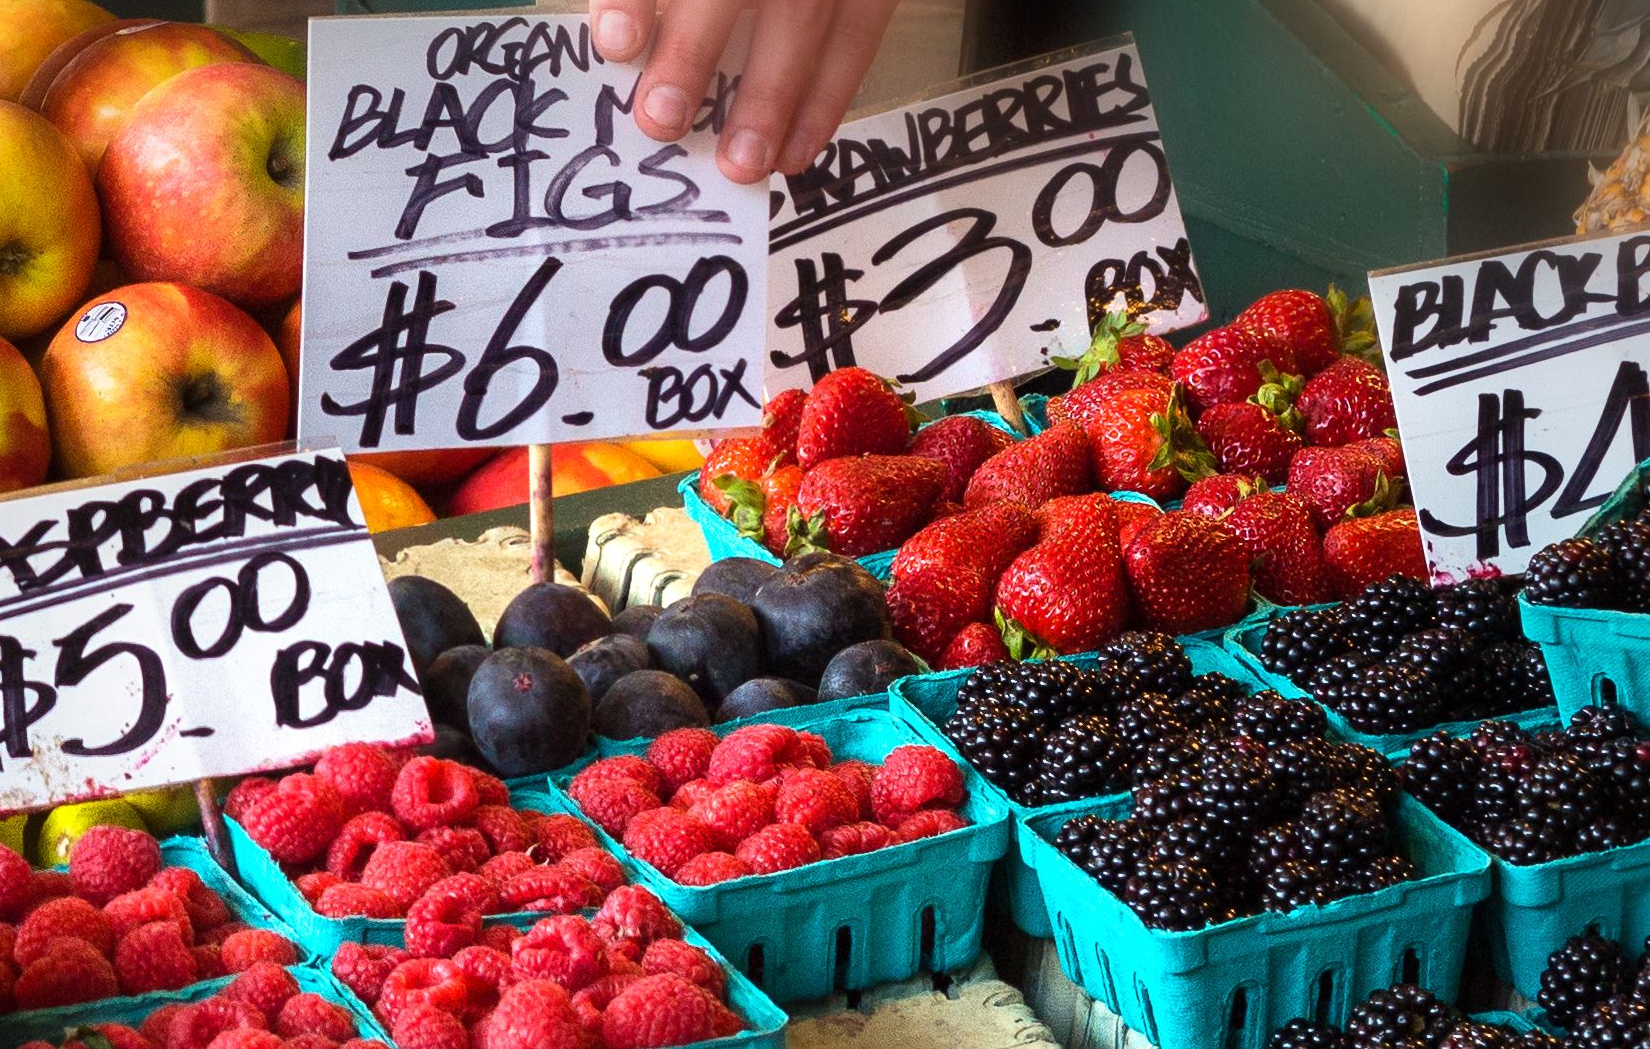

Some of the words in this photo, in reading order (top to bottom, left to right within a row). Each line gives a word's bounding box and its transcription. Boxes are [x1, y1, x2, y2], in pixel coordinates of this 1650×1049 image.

[425, 16, 605, 82] ORGAN
[328, 75, 570, 163] BLACK
[769, 52, 1153, 219] RAWBERRIES
[394, 143, 702, 240] FIGS
[1084, 237, 1205, 338] BOX
[638, 358, 763, 431] BOX
[270, 639, 424, 730] BOX
